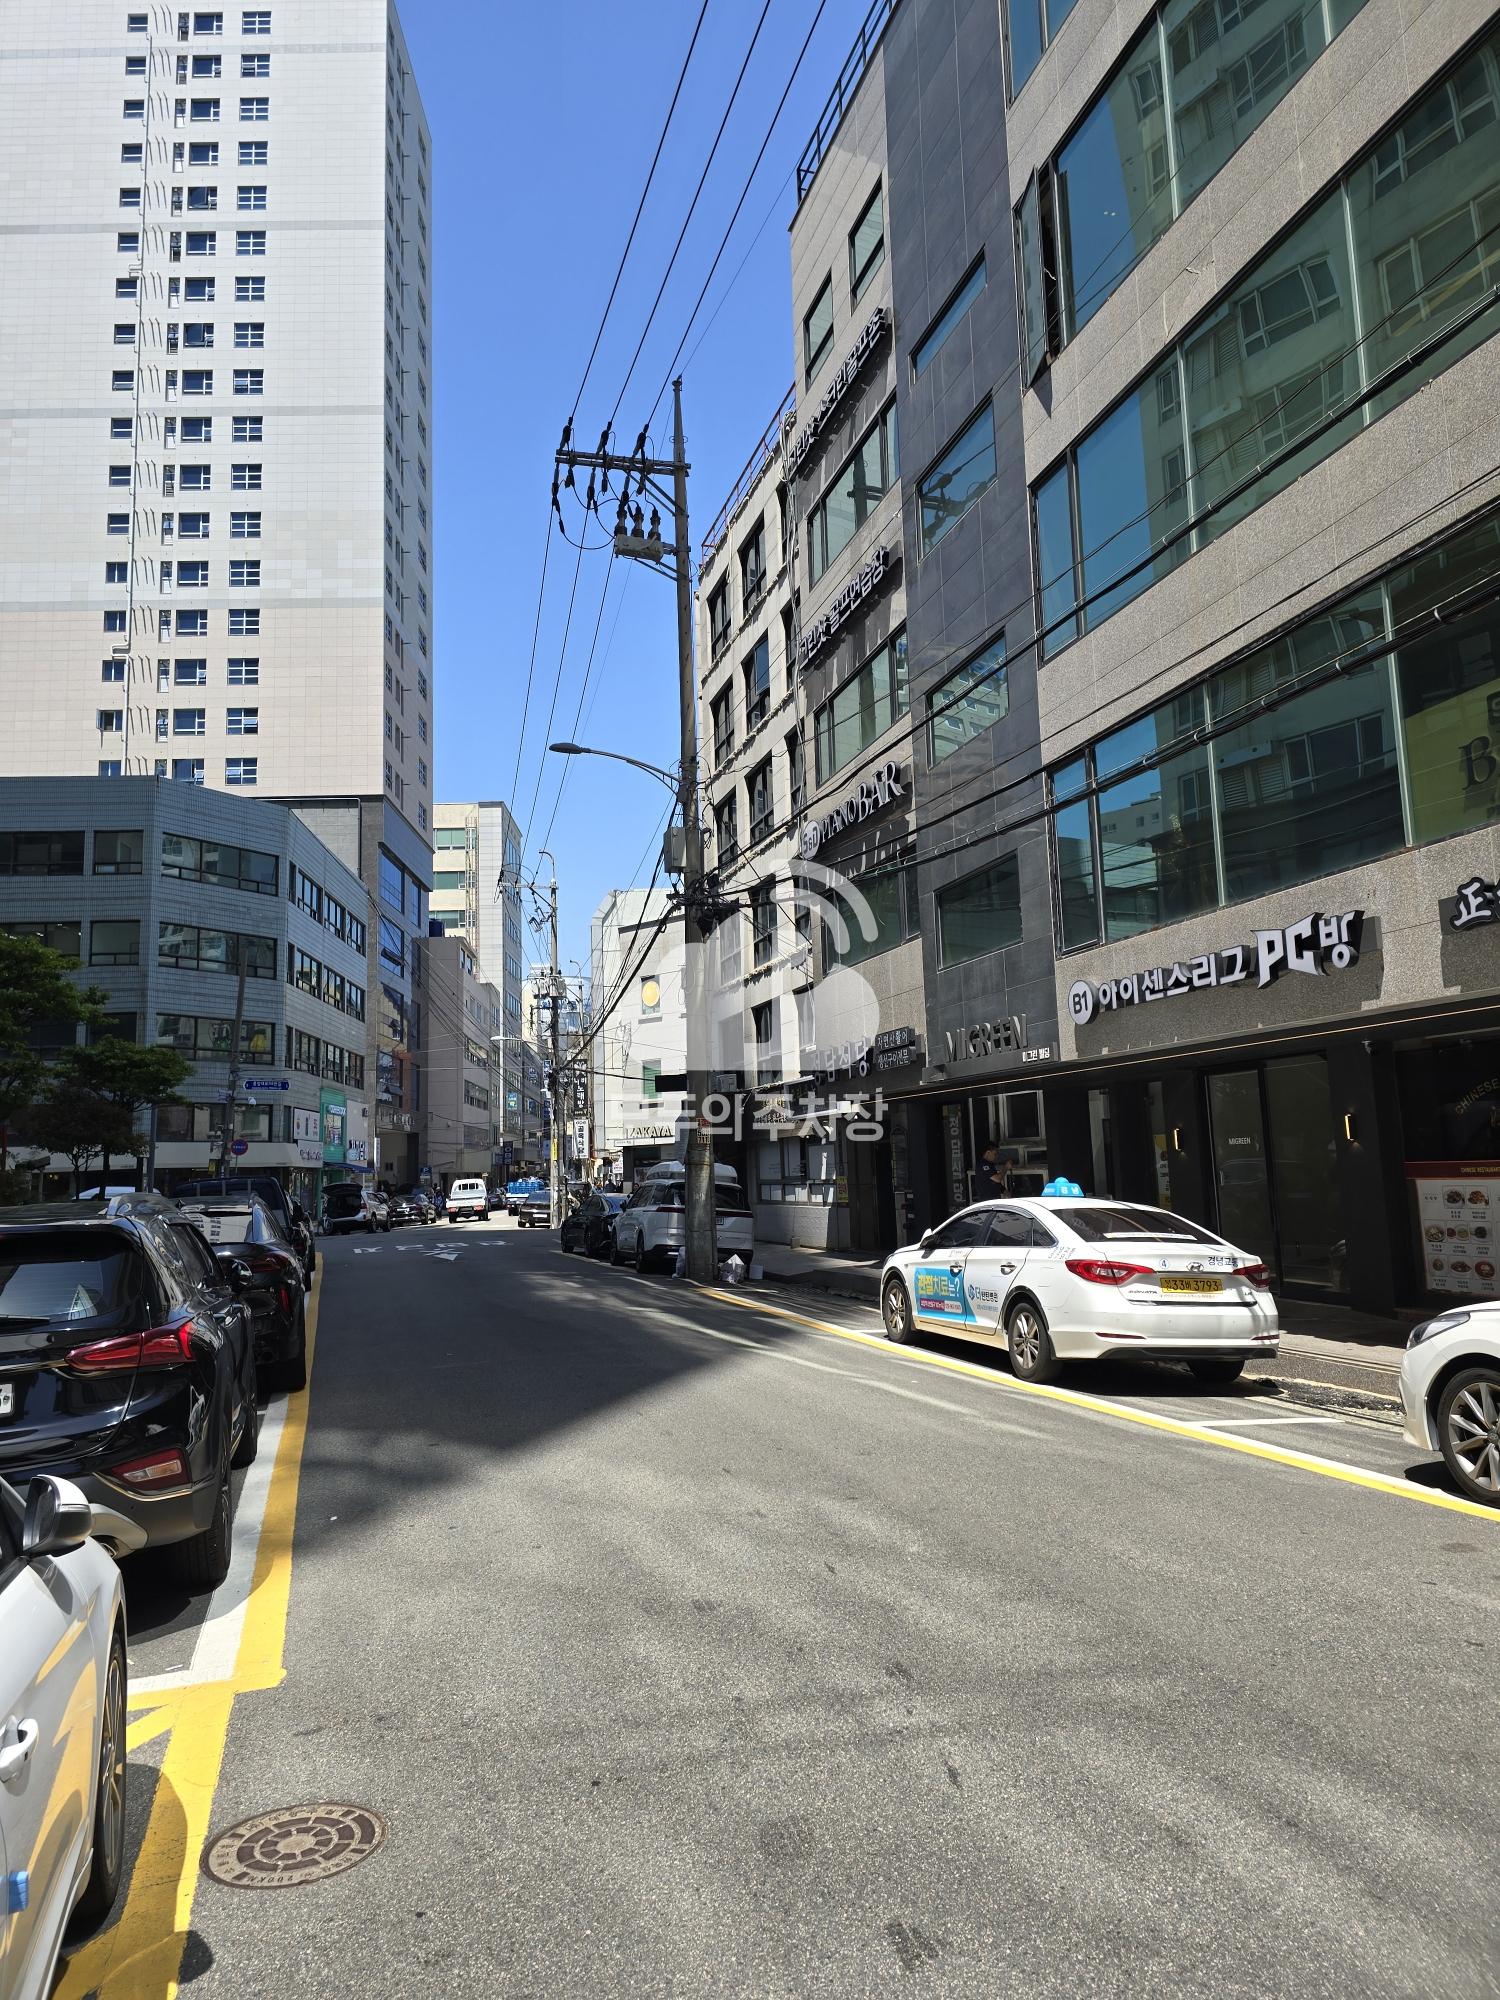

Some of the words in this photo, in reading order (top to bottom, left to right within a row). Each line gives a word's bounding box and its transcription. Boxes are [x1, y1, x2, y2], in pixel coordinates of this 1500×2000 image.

[829, 545, 888, 634] 골프연습장
[1098, 945, 1249, 1010] 아이센스리그
[1250, 911, 1360, 989] PC방
